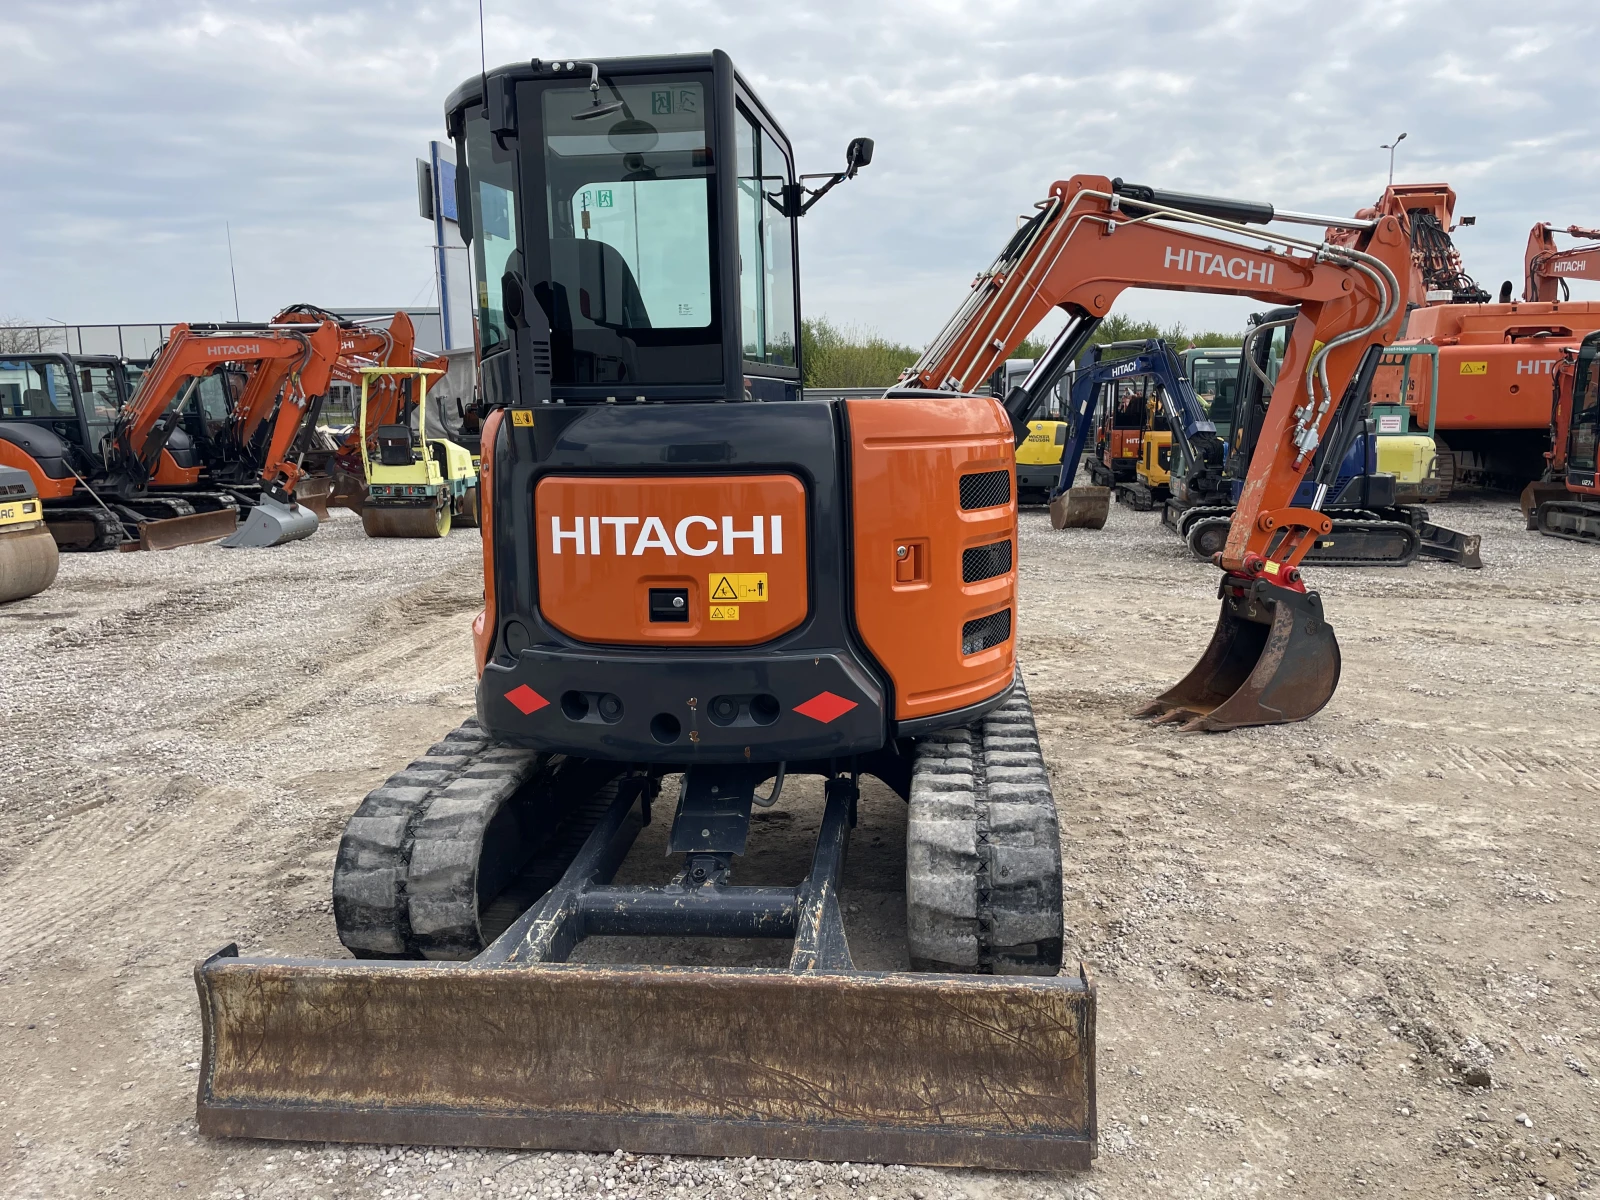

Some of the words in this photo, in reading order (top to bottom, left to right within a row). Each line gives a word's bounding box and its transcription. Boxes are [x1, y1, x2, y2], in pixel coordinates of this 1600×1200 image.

[1164, 246, 1275, 285] HITACHI
[1554, 260, 1586, 272] HITACHI
[207, 344, 260, 356] HITACHI
[1516, 360, 1556, 375] HIT
[551, 515, 783, 557] HITACHI
